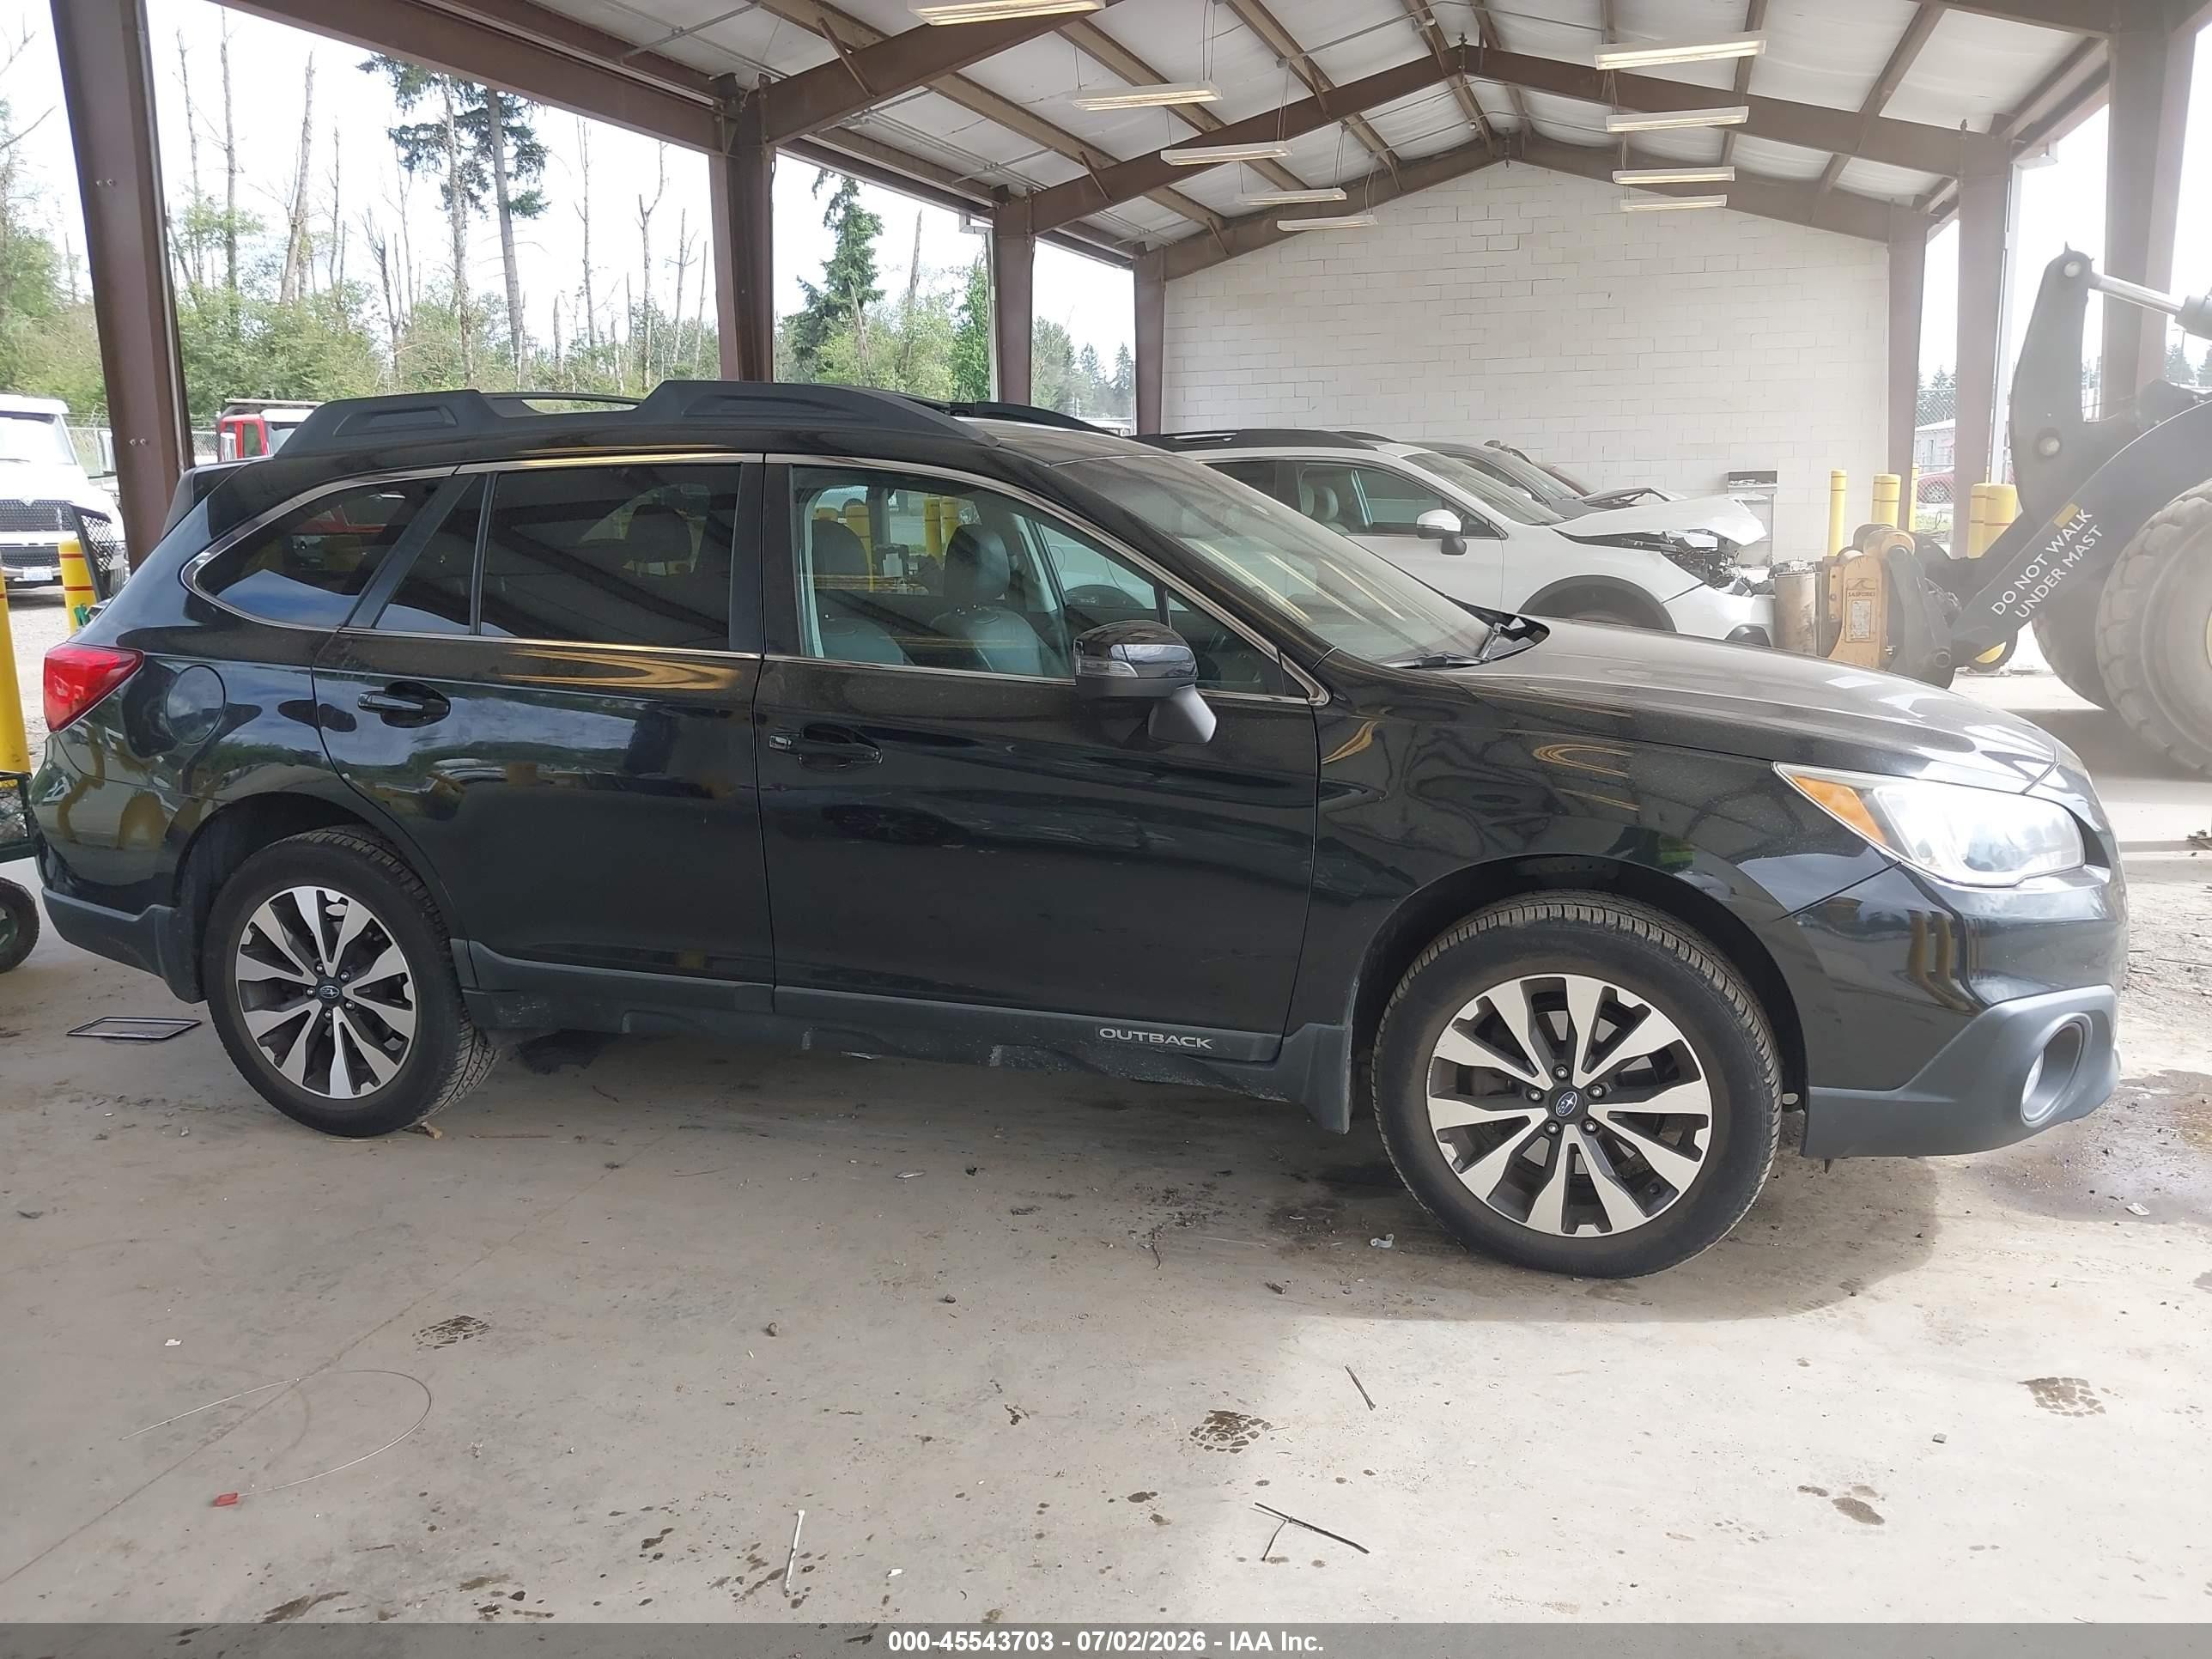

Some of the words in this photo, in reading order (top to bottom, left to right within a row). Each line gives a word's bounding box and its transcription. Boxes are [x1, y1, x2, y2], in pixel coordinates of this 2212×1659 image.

[1991, 591, 2016, 615] DO
[2014, 554, 2048, 590] NOT
[2045, 508, 2093, 552] WALK
[2014, 568, 2067, 617] UNDER
[2062, 525, 2102, 567] MAST
[1099, 1028, 1212, 1049] OUTBACK
